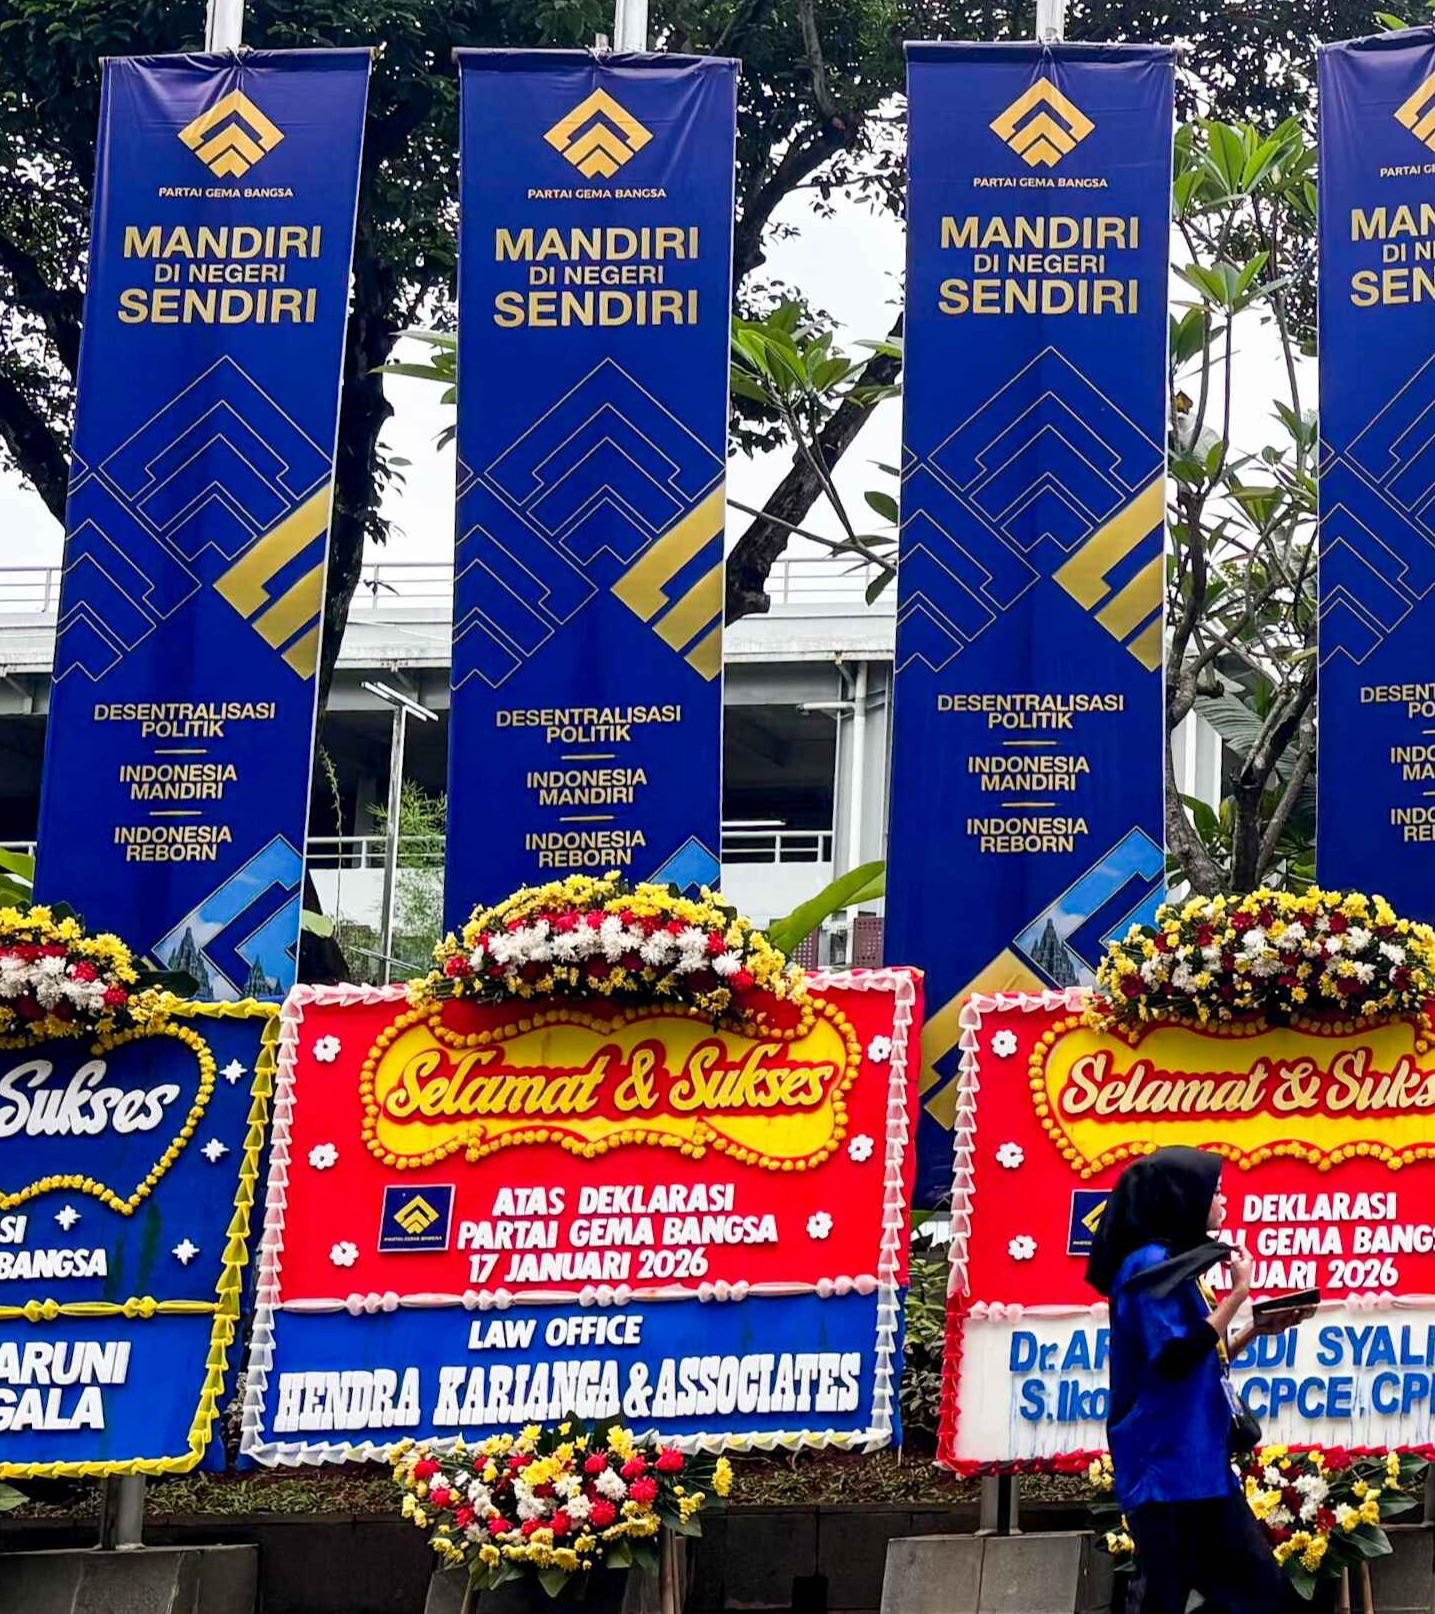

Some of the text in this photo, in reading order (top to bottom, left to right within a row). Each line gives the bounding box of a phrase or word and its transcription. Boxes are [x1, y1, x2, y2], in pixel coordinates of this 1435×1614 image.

[1380, 165, 1421, 177] PARTAI
[974, 178, 1108, 188] PARTAI GEMA BANGSA
[159, 188, 293, 198] PARTAI GEMA BANGSA
[528, 189, 666, 198] PARTAI GEMA BANGSA
[941, 216, 1138, 249] MANDIRI
[124, 226, 321, 259] MANDIRI
[496, 227, 698, 261] MANDIRI
[1383, 243, 1406, 263] DI
[974, 254, 1104, 273] DI NEGERI
[155, 264, 285, 283] DI NEGERI
[530, 266, 663, 285] DI NEGERI
[118, 289, 316, 323] SENDIRI
[939, 279, 1137, 314] SENDIRI
[494, 290, 697, 327] SENDIRI
[94, 703, 275, 720] DESENTRALISASI
[938, 694, 1123, 711] DESENTRALISASI
[497, 705, 680, 726] DESENTRALISASI
[989, 712, 1072, 728] POLITIK
[142, 720, 224, 737] POLITIK
[547, 724, 630, 743] POLITIK
[120, 764, 237, 782] INDONESIA
[969, 756, 1090, 773] INDONESIA
[527, 769, 647, 788] INDONESIA
[981, 774, 1075, 790] MANDIRI
[131, 782, 223, 799] MANDIRI
[540, 787, 633, 805] MANDIRI
[115, 826, 232, 844] INDONESIA
[967, 818, 1088, 835] INDONESIA
[526, 830, 645, 850] INDONESIA
[981, 835, 1073, 852] REBORN
[127, 843, 217, 861] REBORN
[539, 848, 631, 867] REBORN
[387, 1043, 834, 1117] Selamat & Sukses
[1062, 1053, 1268, 1114] Selamat
[1273, 1062, 1320, 1110] &
[0, 1060, 180, 1137] Sukses
[492, 1184, 734, 1216] ATAS DEKLARASI
[1243, 1193, 1396, 1221] DEKLARASI
[458, 1215, 777, 1249] PARTAI GEMA BANGSA
[1258, 1227, 1342, 1255] GEMA
[0, 1249, 107, 1280] BANGSA
[470, 1247, 708, 1282] 17 JANUARI 2026
[1327, 1258, 1398, 1287] 2026
[468, 1315, 643, 1348] LAW OFFICE
[274, 1360, 620, 1432] HENDRA KARIANGA
